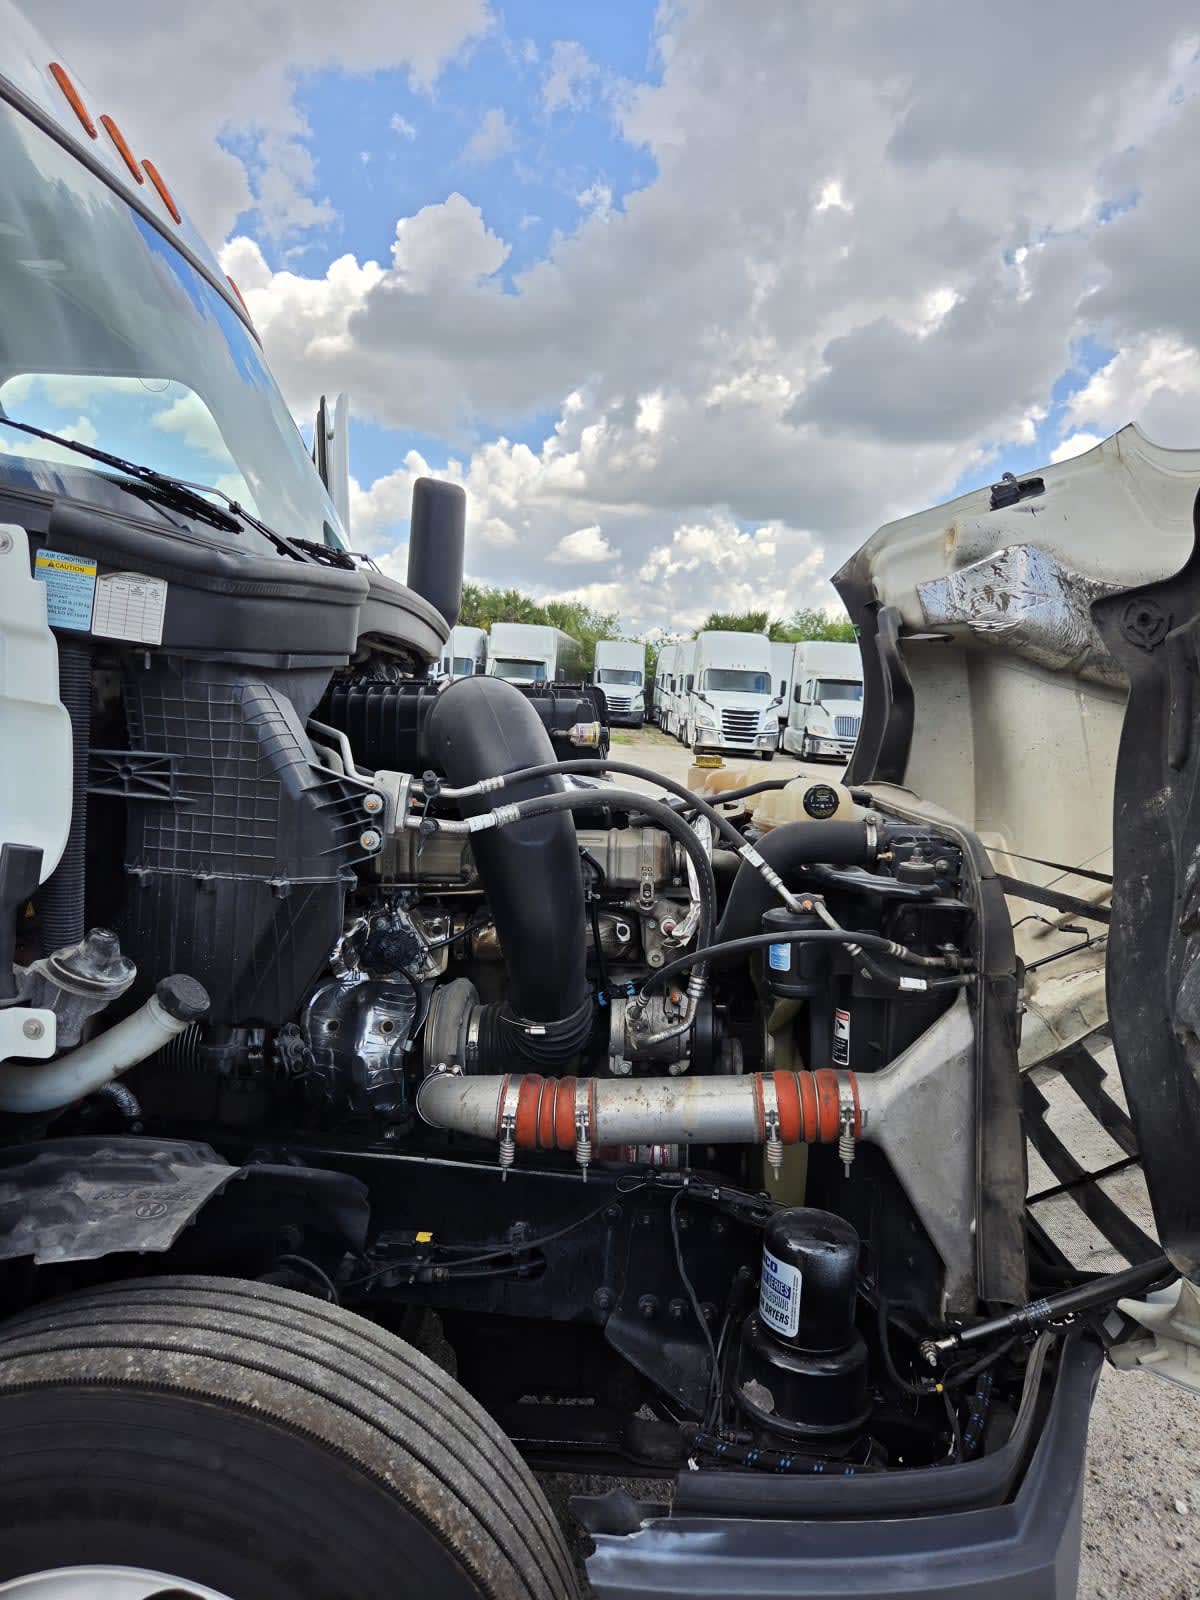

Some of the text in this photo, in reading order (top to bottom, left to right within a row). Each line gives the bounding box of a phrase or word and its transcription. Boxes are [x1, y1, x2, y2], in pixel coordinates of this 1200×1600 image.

[55, 563, 85, 573] CAUTION
[767, 1279, 790, 1298] SERIES
[765, 1303, 790, 1326] DRYERS
